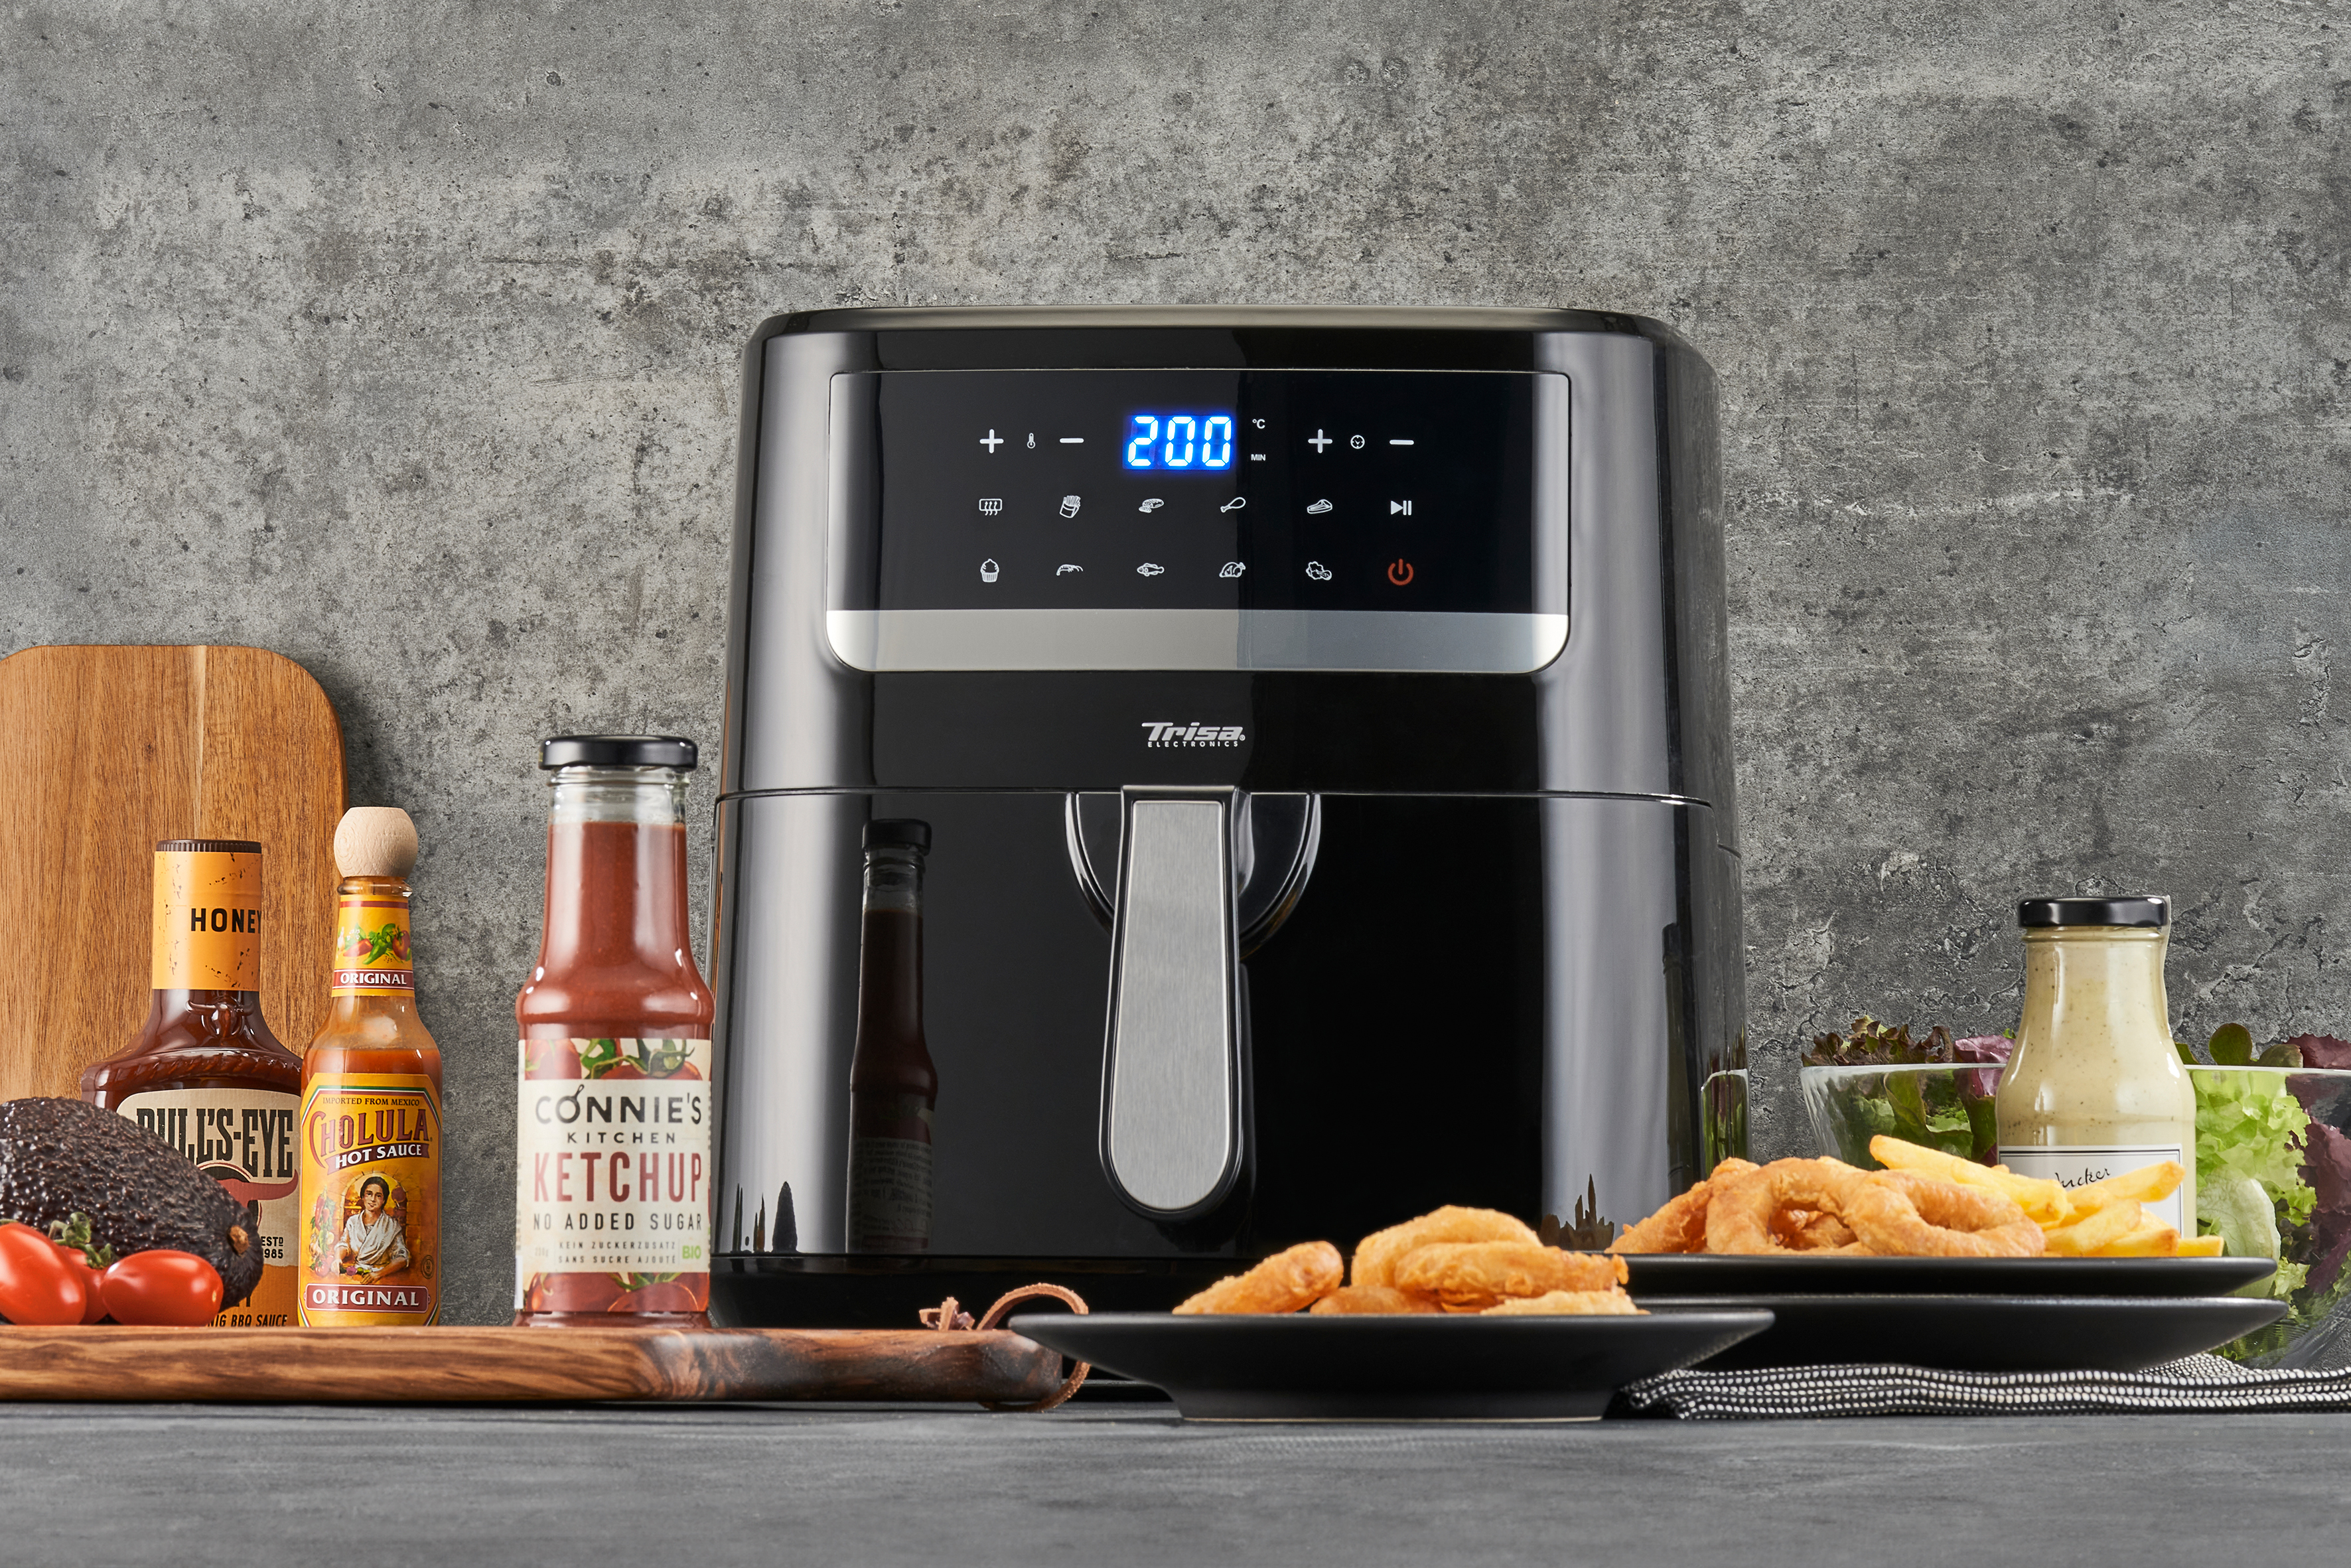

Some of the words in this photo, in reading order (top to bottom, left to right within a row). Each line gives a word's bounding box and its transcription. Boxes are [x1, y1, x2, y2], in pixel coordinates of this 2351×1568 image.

[1127, 416, 1232, 466] 200
[190, 908, 261, 934] HONEY
[340, 973, 407, 985] ORIGINAL
[535, 1085, 701, 1125] CONNIE'S
[309, 1109, 430, 1169] CHOLULA
[567, 1132, 675, 1144] KITCHEN
[335, 1148, 372, 1170] HOT
[376, 1144, 422, 1159] SAUCE
[534, 1151, 701, 1202] KETCHUP
[534, 1213, 551, 1230] NO
[565, 1213, 634, 1230] ADDED
[650, 1213, 701, 1230] SUGAR
[264, 1248, 283, 1259] 985
[559, 1255, 585, 1264] SANS
[593, 1255, 629, 1264] SUCRE
[681, 1245, 701, 1259] BIO
[313, 1289, 419, 1307] ORIGINAL
[231, 1314, 252, 1326] BBQ
[256, 1314, 287, 1326] SAUCE
